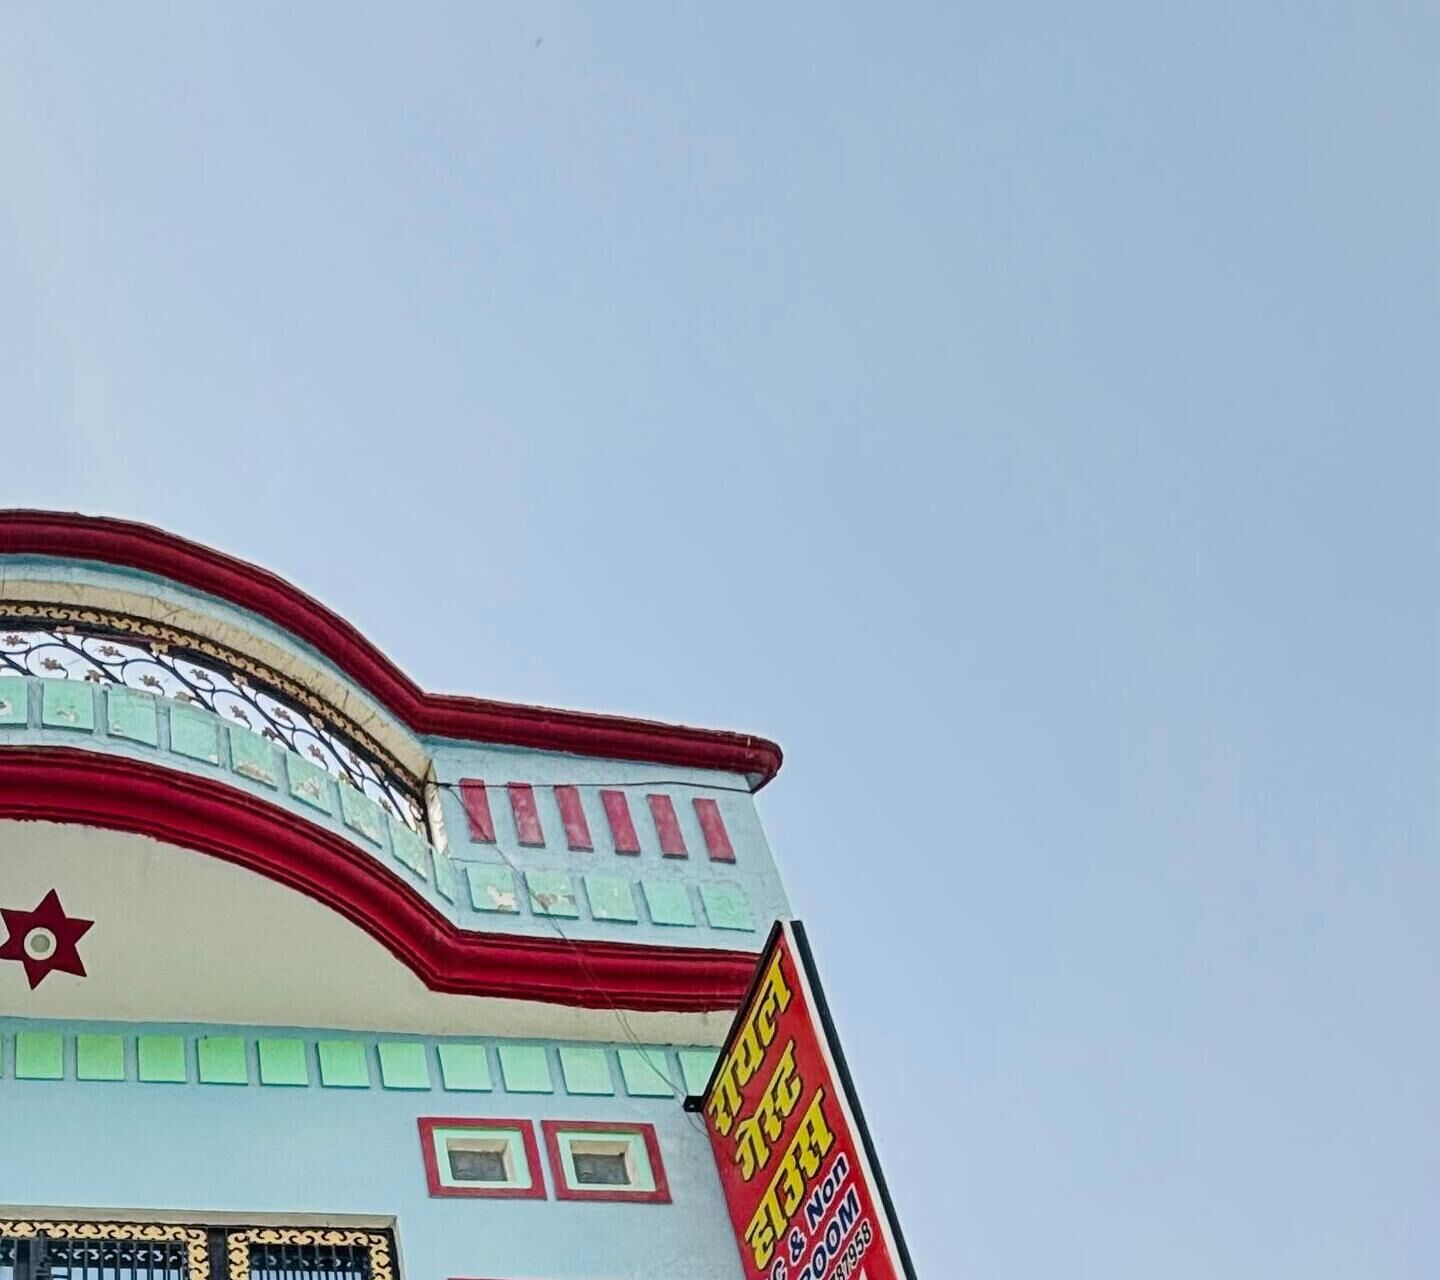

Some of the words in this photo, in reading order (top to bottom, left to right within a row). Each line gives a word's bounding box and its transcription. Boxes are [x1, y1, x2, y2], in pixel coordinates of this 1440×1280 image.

[735, 1039, 802, 1181] गेस्ट
[745, 1087, 833, 1271] हाउस
[789, 1226, 807, 1266] &
[805, 1152, 850, 1235] Non
